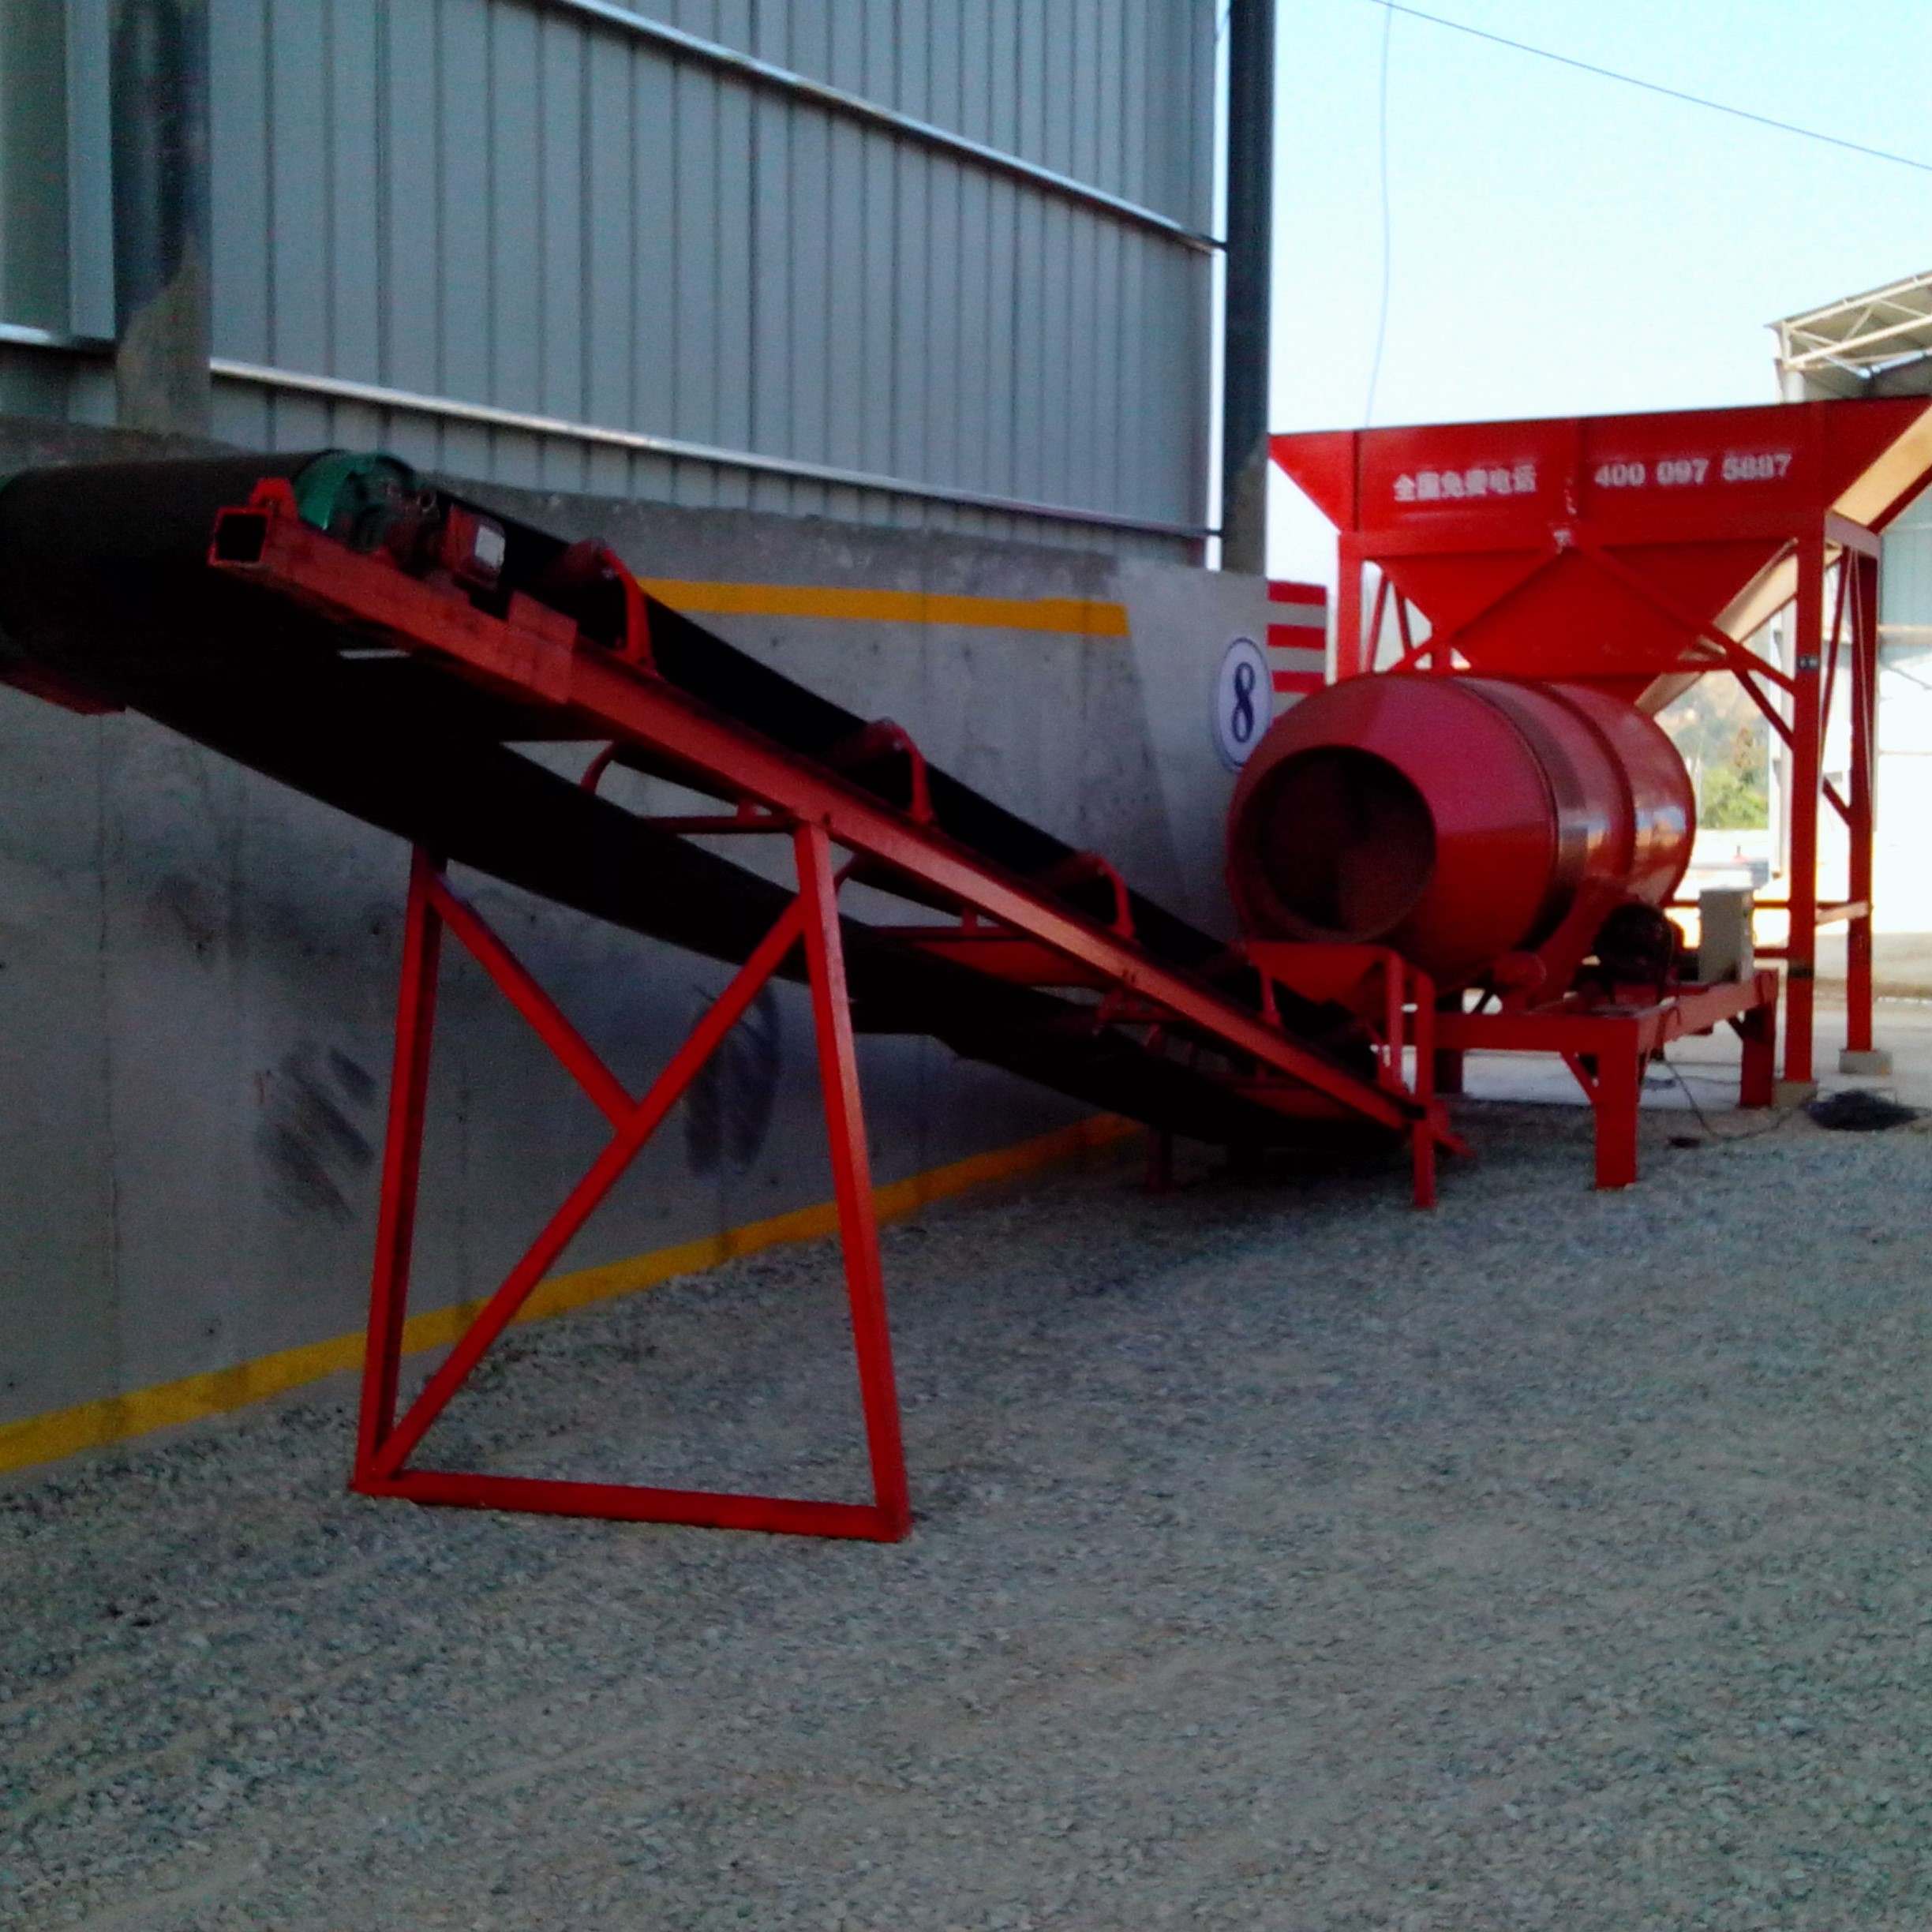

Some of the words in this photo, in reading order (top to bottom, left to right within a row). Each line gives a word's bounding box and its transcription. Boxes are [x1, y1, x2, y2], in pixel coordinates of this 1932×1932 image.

[1594, 461, 1646, 487] 400
[1656, 458, 1709, 485] 097
[1231, 661, 1256, 743] 8
